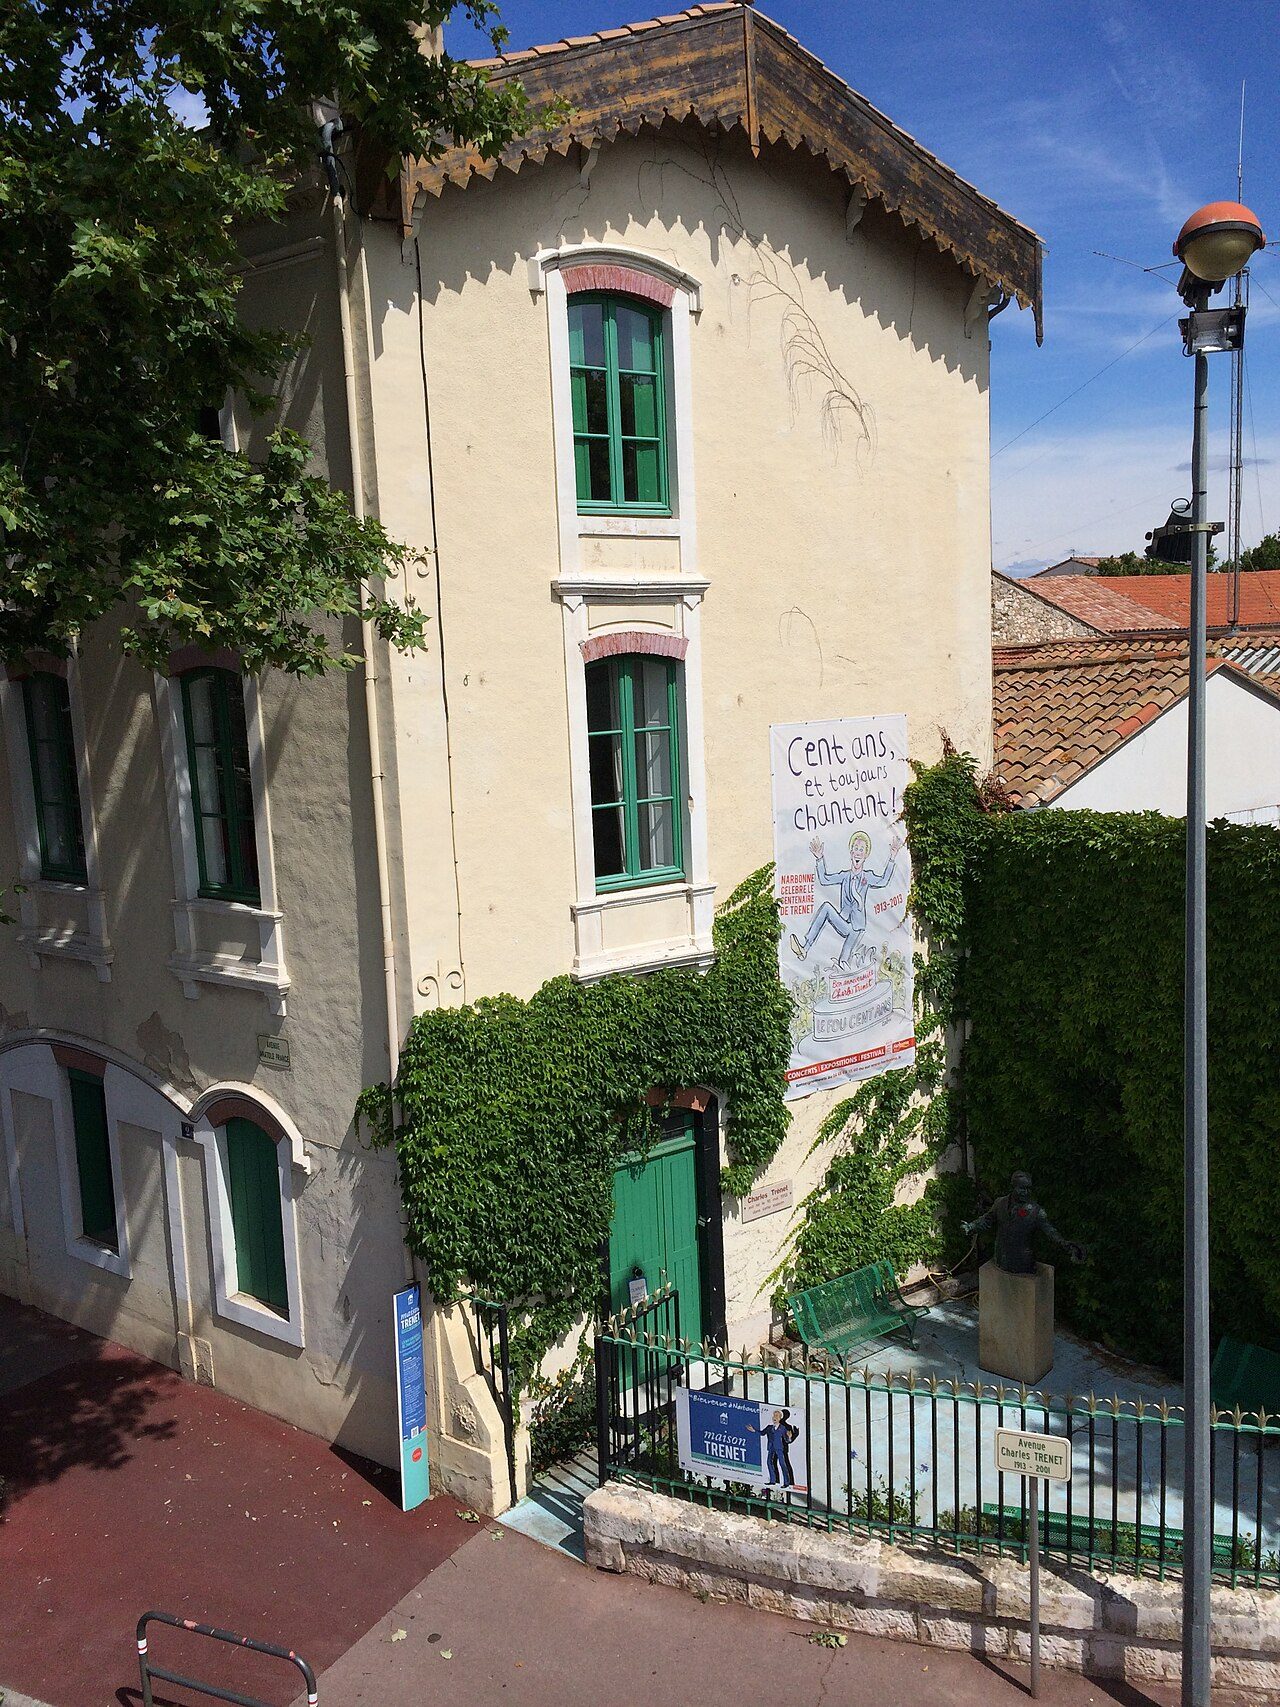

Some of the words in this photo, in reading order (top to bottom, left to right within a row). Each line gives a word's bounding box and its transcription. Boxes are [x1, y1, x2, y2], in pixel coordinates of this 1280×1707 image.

[788, 735, 846, 776] Cent
[851, 731, 895, 760] ans,
[805, 776, 824, 797] et
[829, 765, 888, 791] toujours
[781, 874, 815, 884] NARBONNE
[808, 884, 815, 893] LE
[781, 895, 815, 904] CENTENAIRE
[873, 894, 903, 914] 1913-2013
[781, 906, 788, 916] DE
[790, 905, 814, 915] TRENET
[848, 1007, 875, 1029] CENT
[787, 1066, 818, 1080] CONCERTS
[820, 1056, 858, 1071] EXPOSITIONS
[860, 1048, 885, 1061] FESTIVAL
[747, 1193, 767, 1203] Charles
[401, 1312, 421, 1329] TRENET
[703, 1430, 747, 1447] maison
[1018, 1438, 1046, 1451] Avenue
[704, 1440, 747, 1462] TRENET
[1001, 1446, 1030, 1460] Charles
[1034, 1452, 1063, 1465] TRENET
[1014, 1461, 1026, 1470] 1913
[1036, 1465, 1051, 1474] 2001
